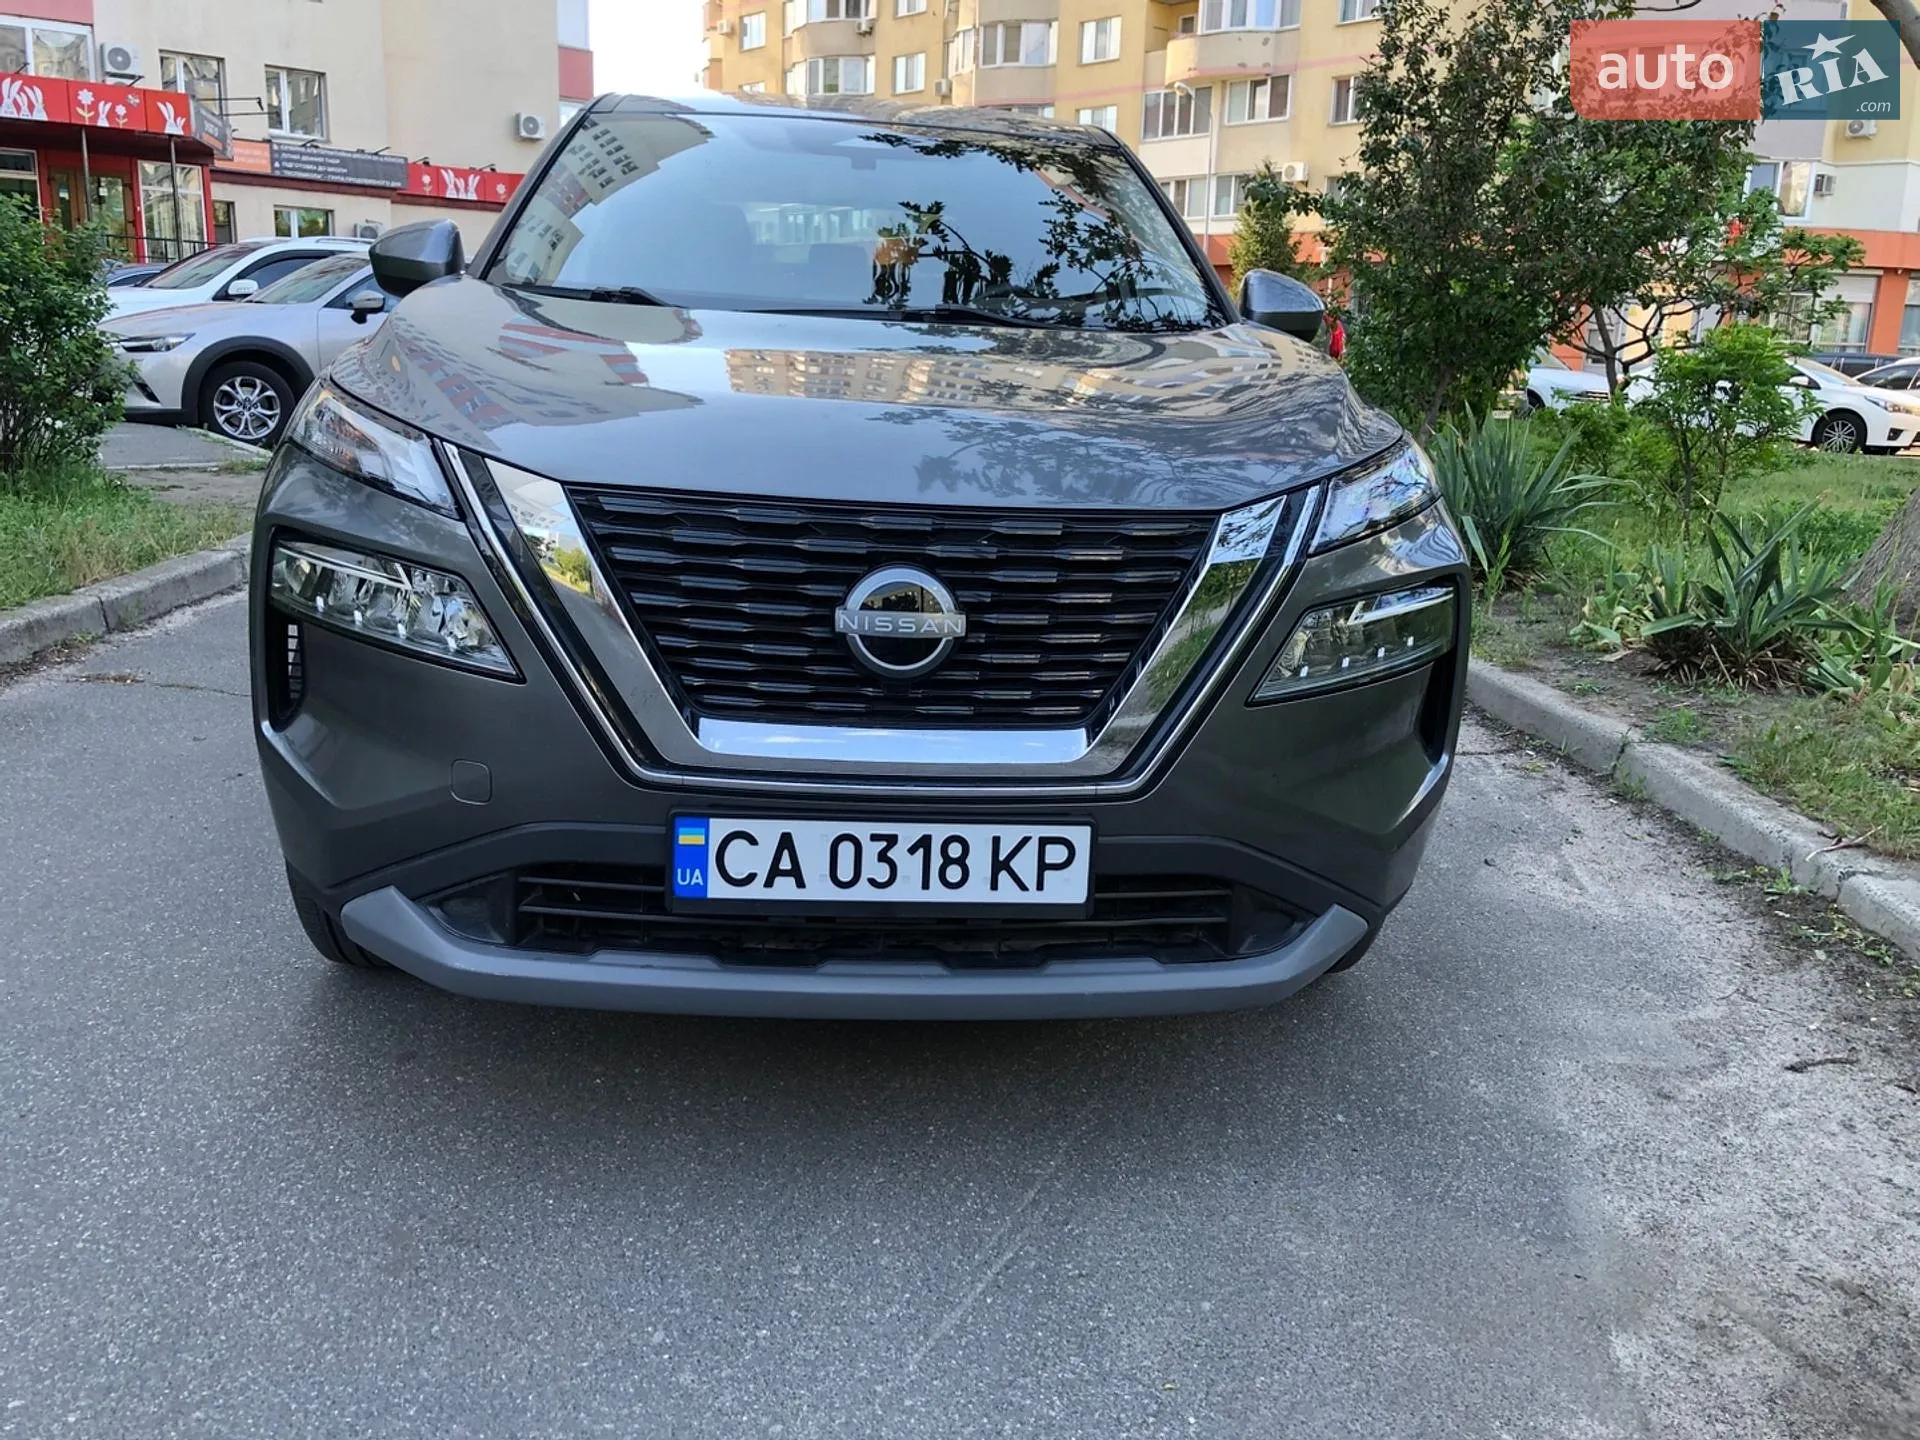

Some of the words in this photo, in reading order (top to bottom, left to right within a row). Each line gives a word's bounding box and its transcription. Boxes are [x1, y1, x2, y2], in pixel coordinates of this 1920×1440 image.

[839, 611, 962, 634] NISSAN
[715, 830, 807, 889] CA
[829, 833, 971, 891] 0318
[989, 835, 1077, 892] KP
[677, 868, 704, 886] UA
